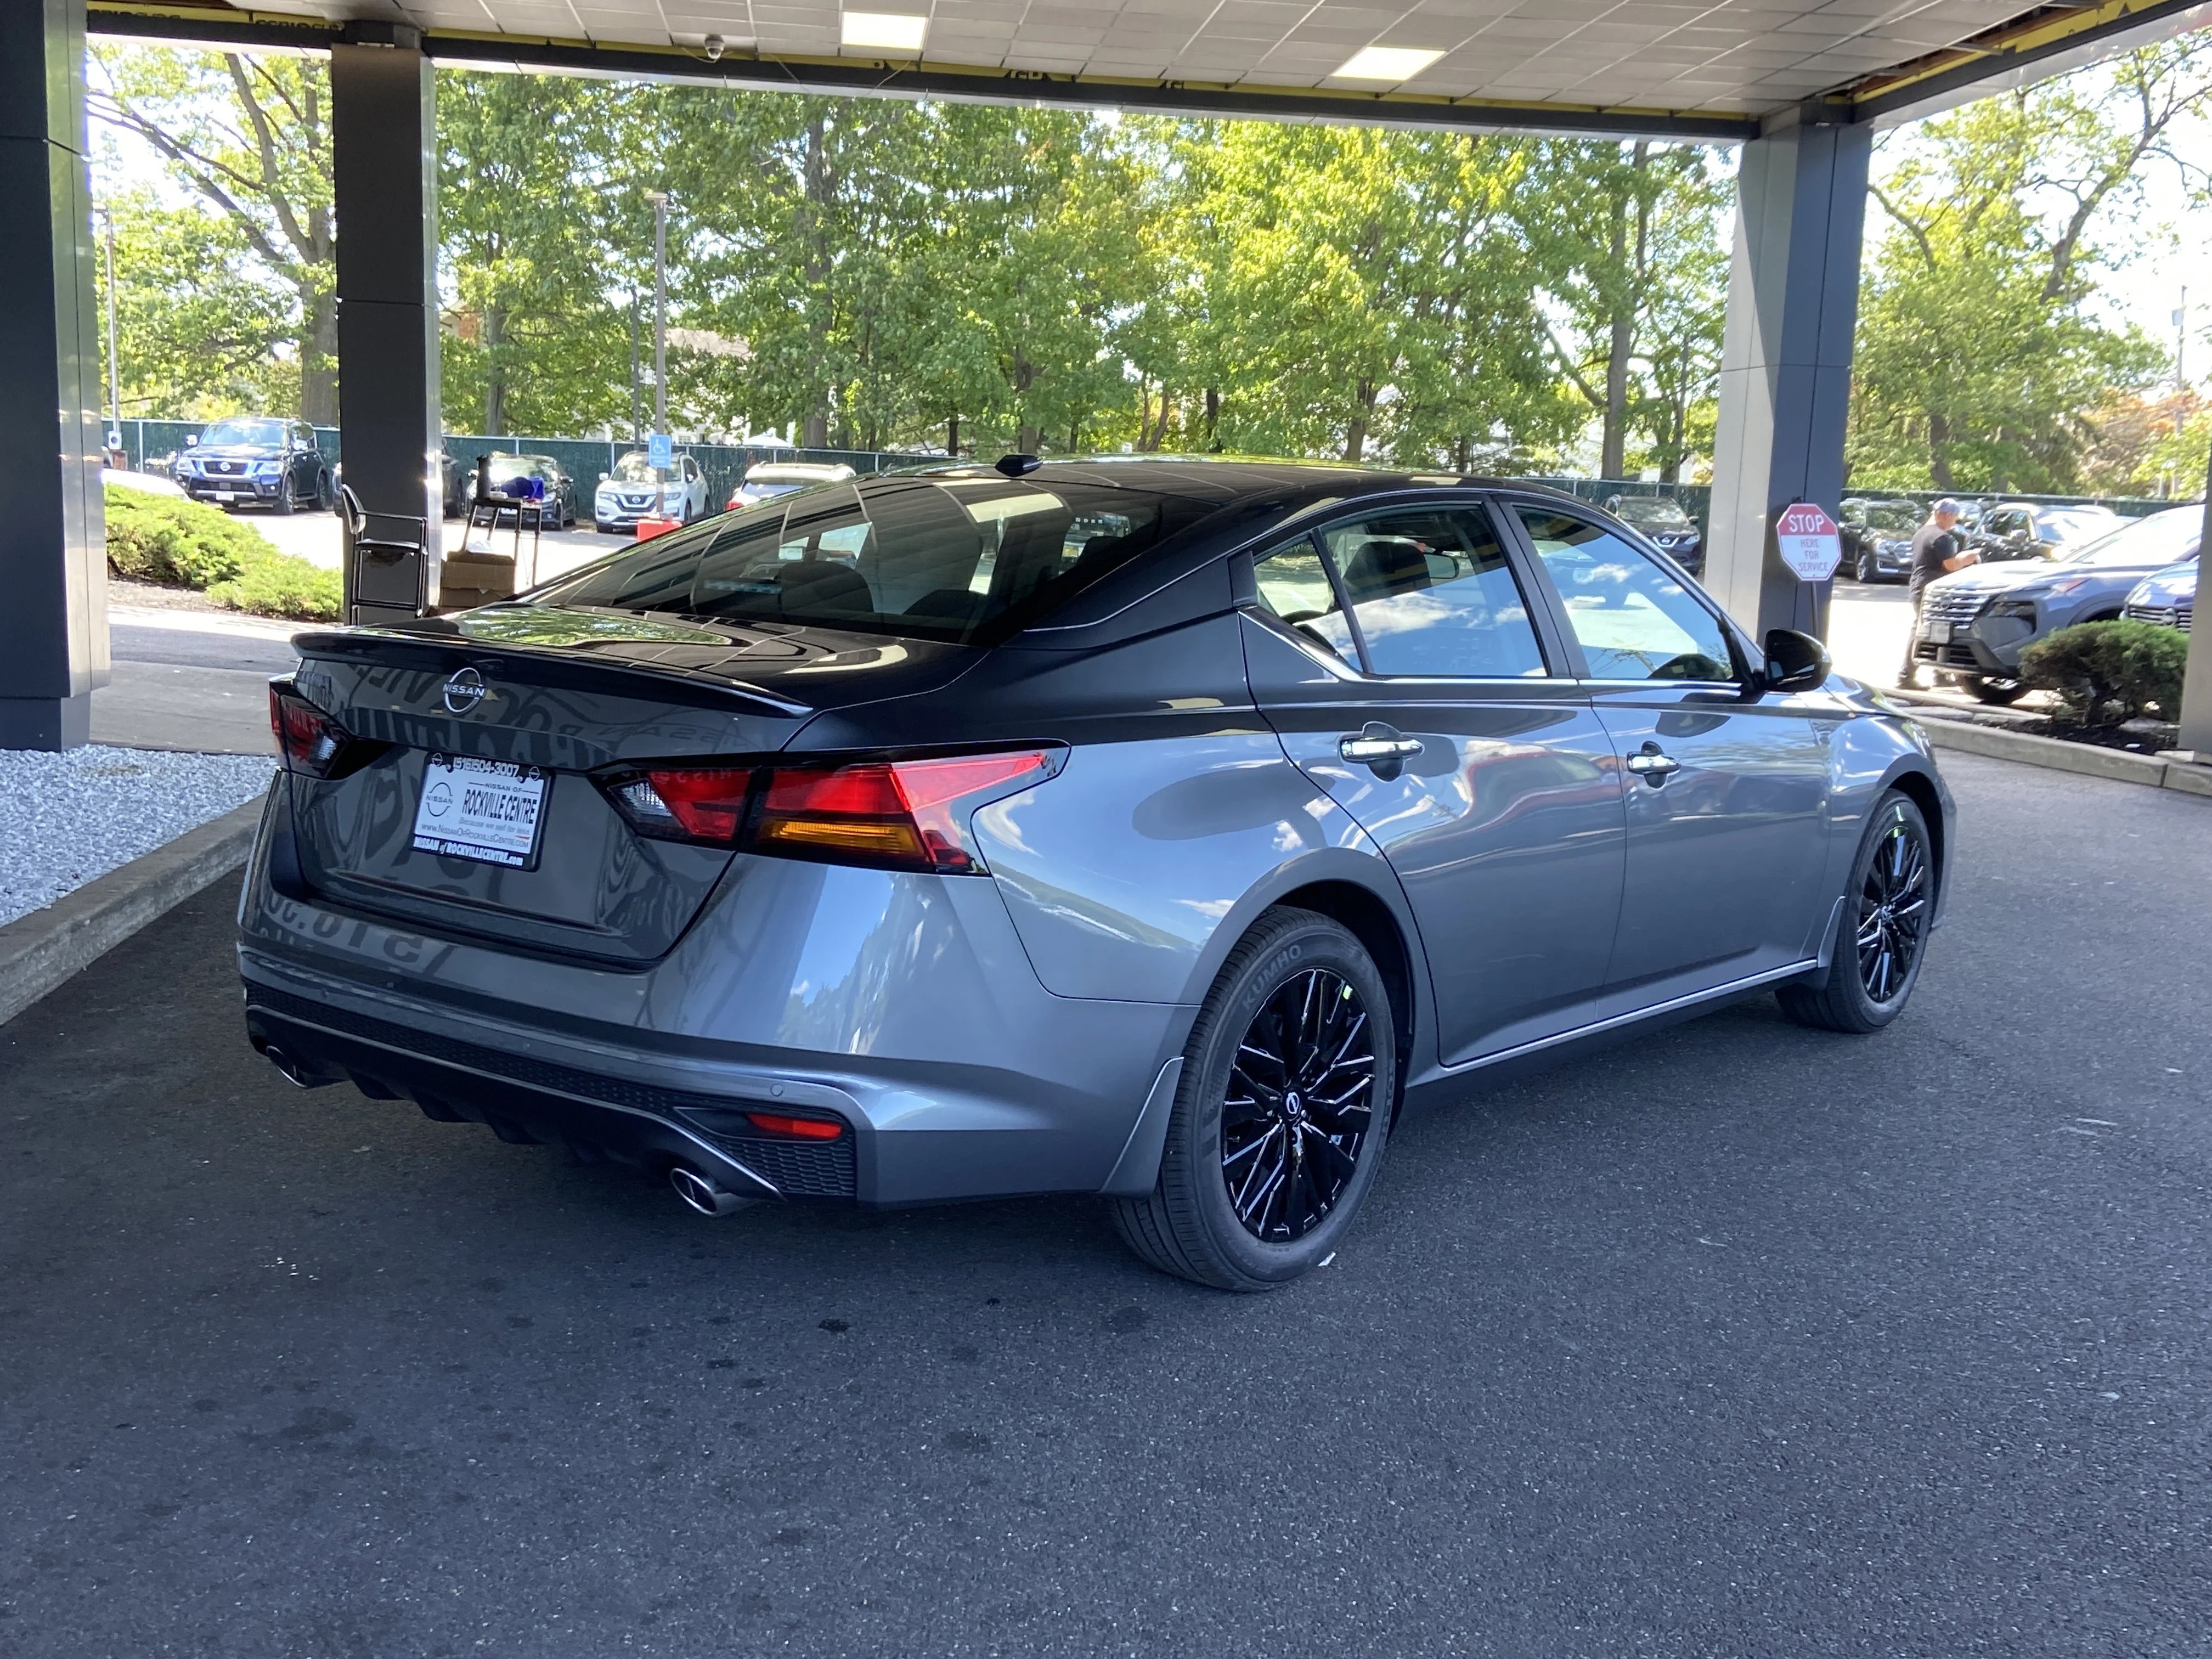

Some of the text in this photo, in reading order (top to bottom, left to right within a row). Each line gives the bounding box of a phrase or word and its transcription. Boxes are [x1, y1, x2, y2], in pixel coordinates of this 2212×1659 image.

[1788, 514, 1824, 533] STOP
[1800, 539, 1820, 548] HERE
[1804, 550, 1819, 560] FOR
[1798, 562, 1829, 572] SERVICE
[443, 684, 485, 696] NISSAN
[484, 783, 511, 791] NISSAN
[426, 795, 453, 804] NISSAN
[462, 789, 537, 825] ROCKVILLE CENTRE
[459, 817, 484, 828] Because
[413, 836, 439, 851] NISSAN
[1242, 944, 1302, 1011] KUMHO
